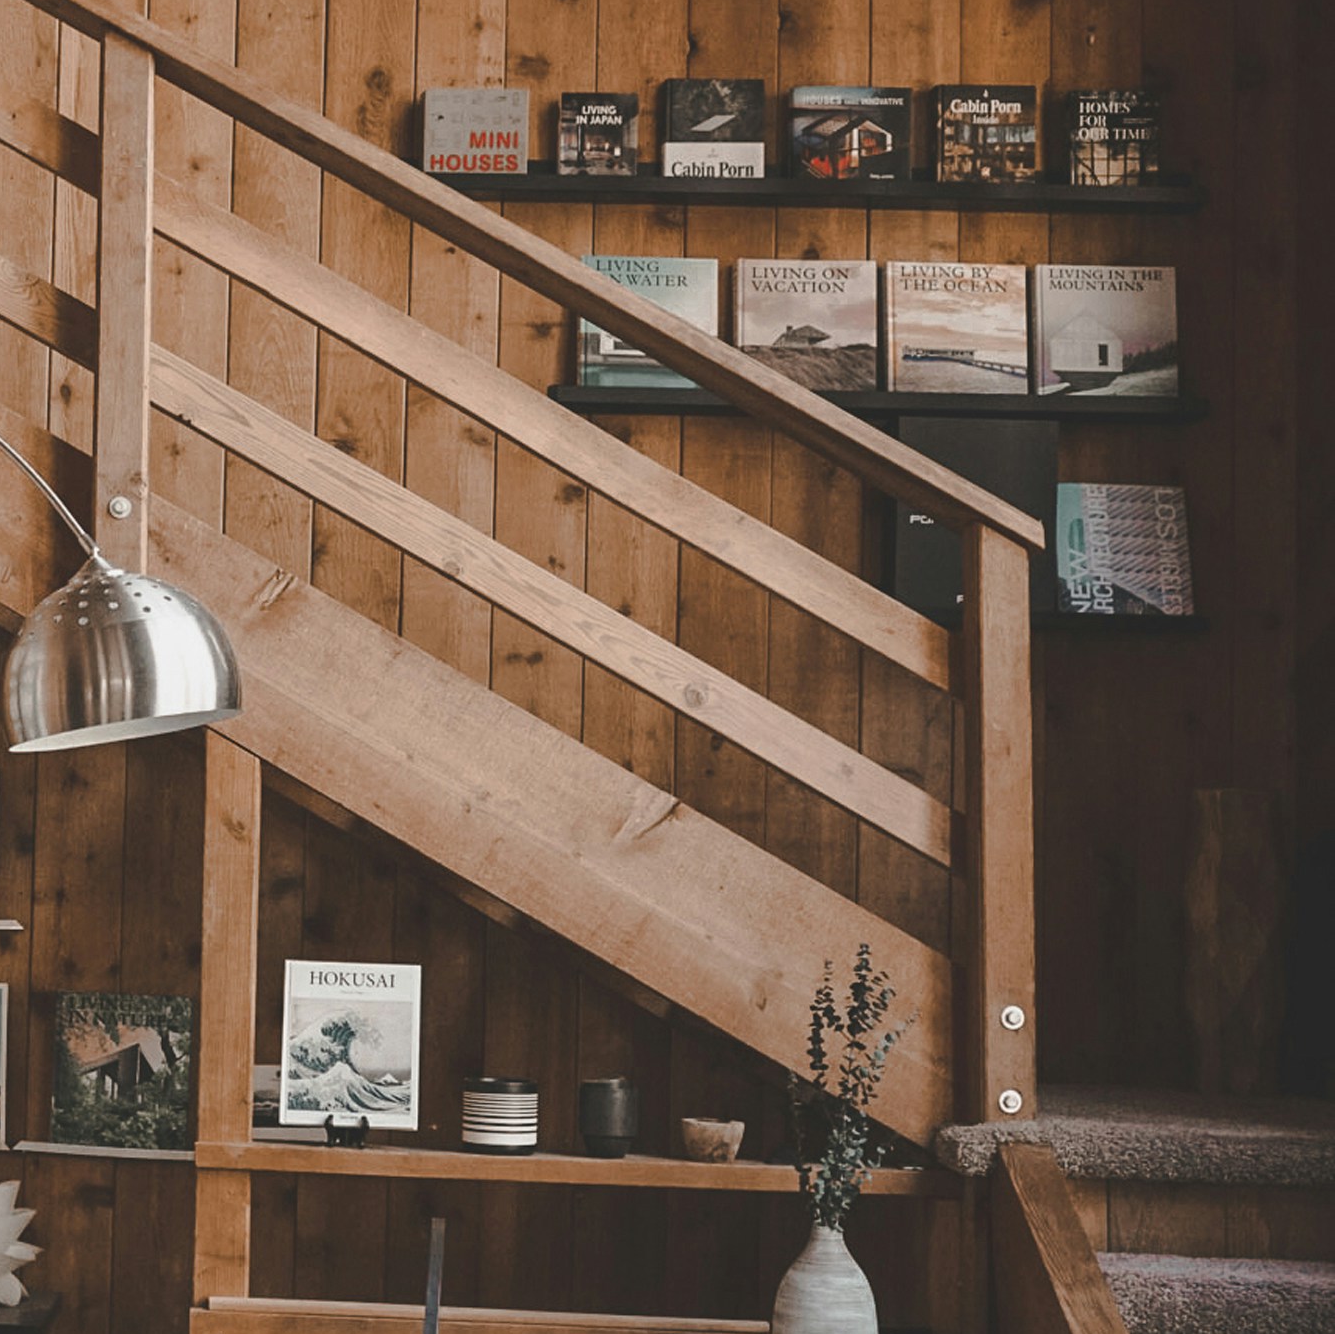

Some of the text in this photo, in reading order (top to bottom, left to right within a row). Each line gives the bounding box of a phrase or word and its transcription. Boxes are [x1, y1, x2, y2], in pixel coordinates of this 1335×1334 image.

[582, 105, 617, 115] LIVING
[950, 99, 1022, 114] Cabin Porn
[1079, 101, 1131, 114] HOMES
[576, 115, 622, 125] IN JAPAN
[1079, 115, 1106, 127] FOR
[469, 131, 519, 149] MINI
[1078, 127, 1150, 141] OUR TIME
[430, 154, 519, 171] HOUSES
[671, 161, 754, 177] Cabin Porn
[596, 259, 660, 273] LIVING
[901, 265, 993, 279] LIVING BY
[626, 274, 688, 287] WATER
[752, 267, 849, 280] LIVING ON
[1049, 268, 1163, 281] LIVING IN THE
[751, 280, 845, 293] VACATION
[900, 278, 1008, 293] THE OCEAN
[1049, 280, 1144, 292] MOUNTAINS
[1155, 489, 1183, 615] LOS ANGELES
[309, 970, 395, 988] HOKUSAI
